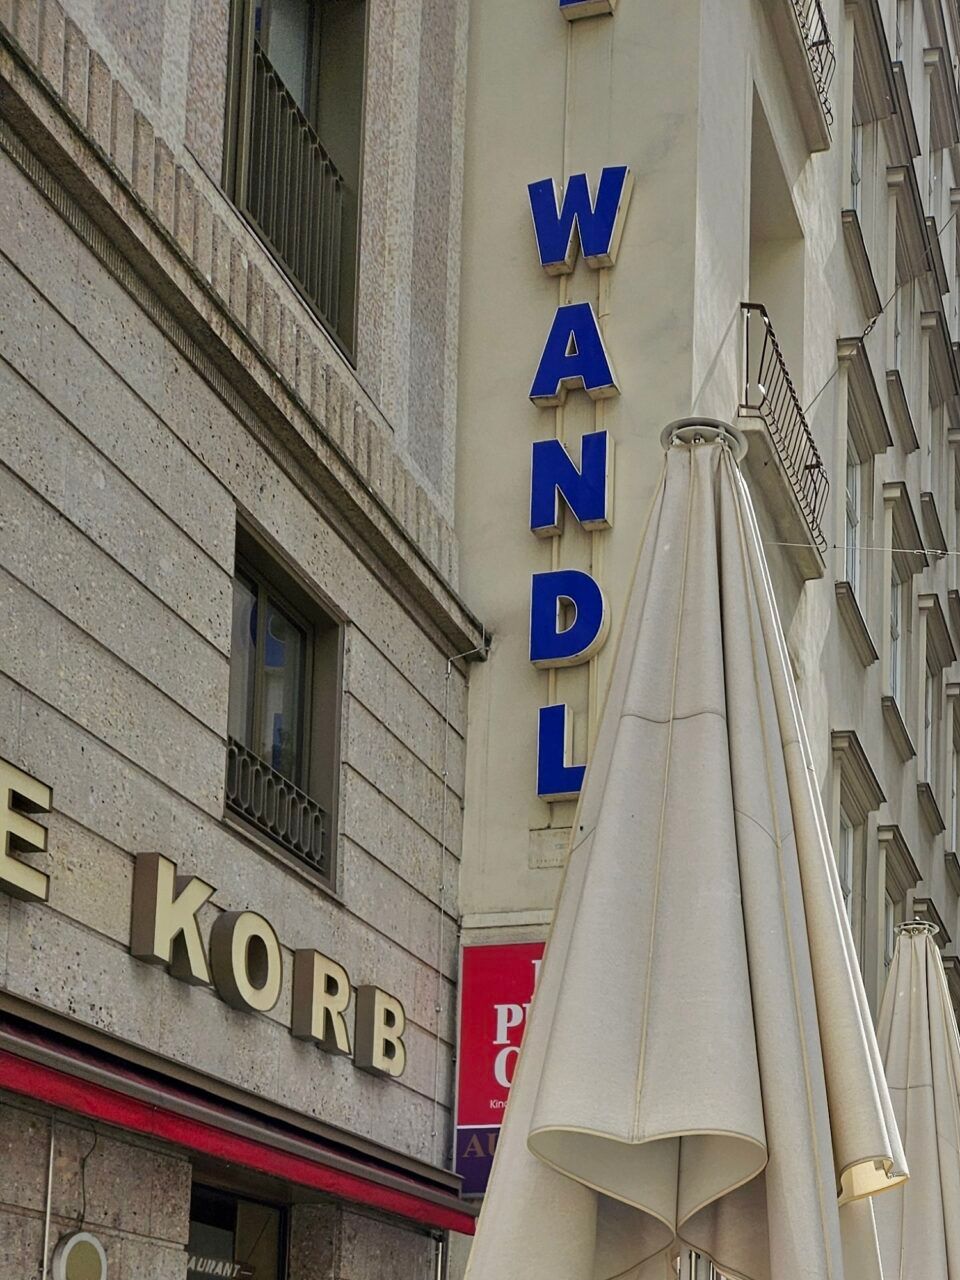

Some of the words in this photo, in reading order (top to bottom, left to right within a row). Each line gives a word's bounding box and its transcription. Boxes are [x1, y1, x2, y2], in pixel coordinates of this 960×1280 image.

[527, 165, 634, 801] WANDL
[130, 851, 407, 1078] KORB
[188, 1256, 241, 1278] AURANT
